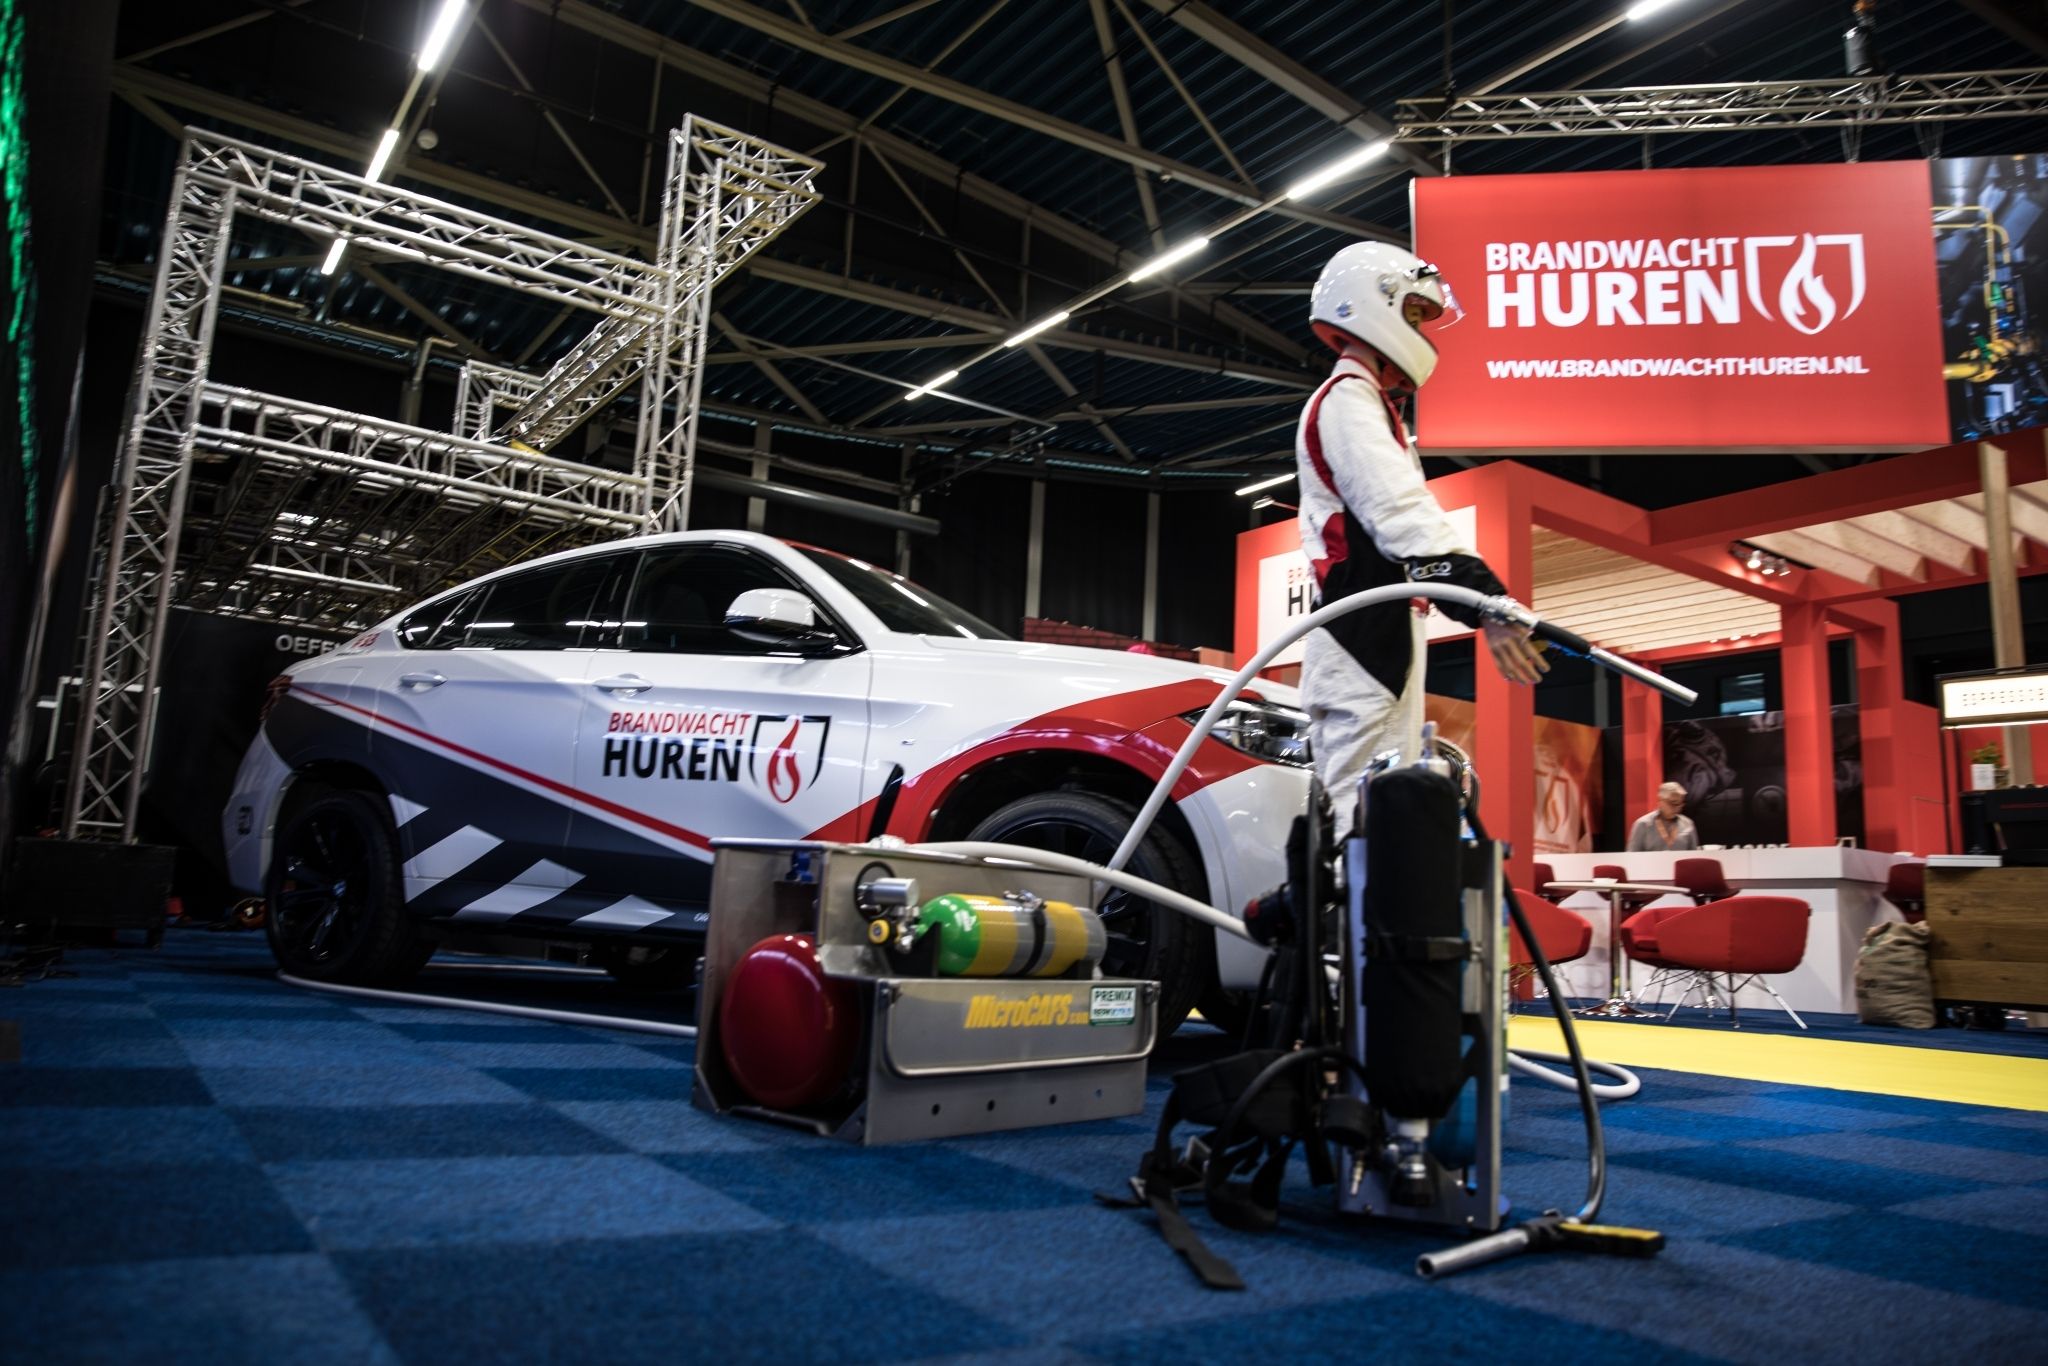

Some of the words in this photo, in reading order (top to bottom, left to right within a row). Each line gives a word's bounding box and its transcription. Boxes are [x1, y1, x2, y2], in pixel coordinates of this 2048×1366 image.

[1485, 236, 1739, 271] BRANDWACHT
[1487, 269, 1741, 328] HUREN
[1487, 356, 1869, 379] WWW.BRANDWACHTHUREN.NL
[608, 711, 751, 736] BRANDWACHT
[602, 737, 743, 782] HUREN
[1094, 990, 1134, 1002] PREMIX
